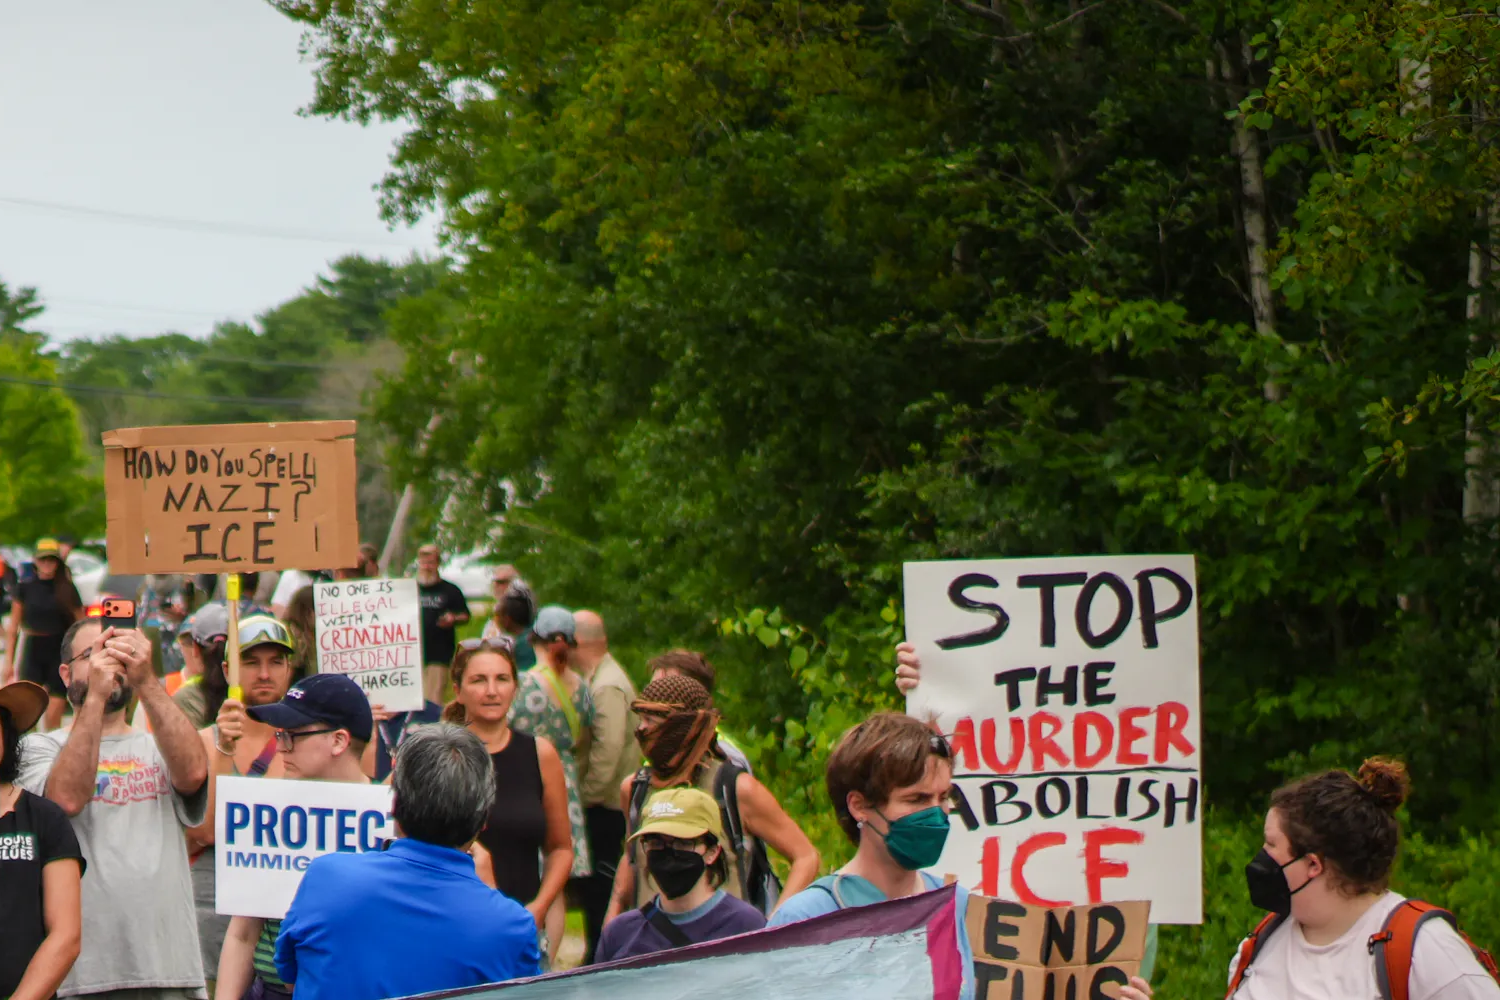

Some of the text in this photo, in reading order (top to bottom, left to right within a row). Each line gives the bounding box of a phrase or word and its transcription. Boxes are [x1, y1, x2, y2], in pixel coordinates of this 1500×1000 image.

[124, 447, 177, 479] HOW
[321, 581, 394, 598] NO ONE IS
[318, 596, 399, 616] ILLEGAL
[323, 613, 380, 628] WITH A
[934, 567, 1193, 650] STOP
[320, 622, 418, 651] CRIMINAL
[322, 645, 412, 673] PRESIDENT
[352, 671, 415, 691] HARGE.
[994, 661, 1116, 712] THE
[930, 701, 1195, 774] MURDER
[947, 775, 1199, 831] ABOLISH
[225, 801, 393, 854] PROTEC
[984, 900, 1125, 966] END
